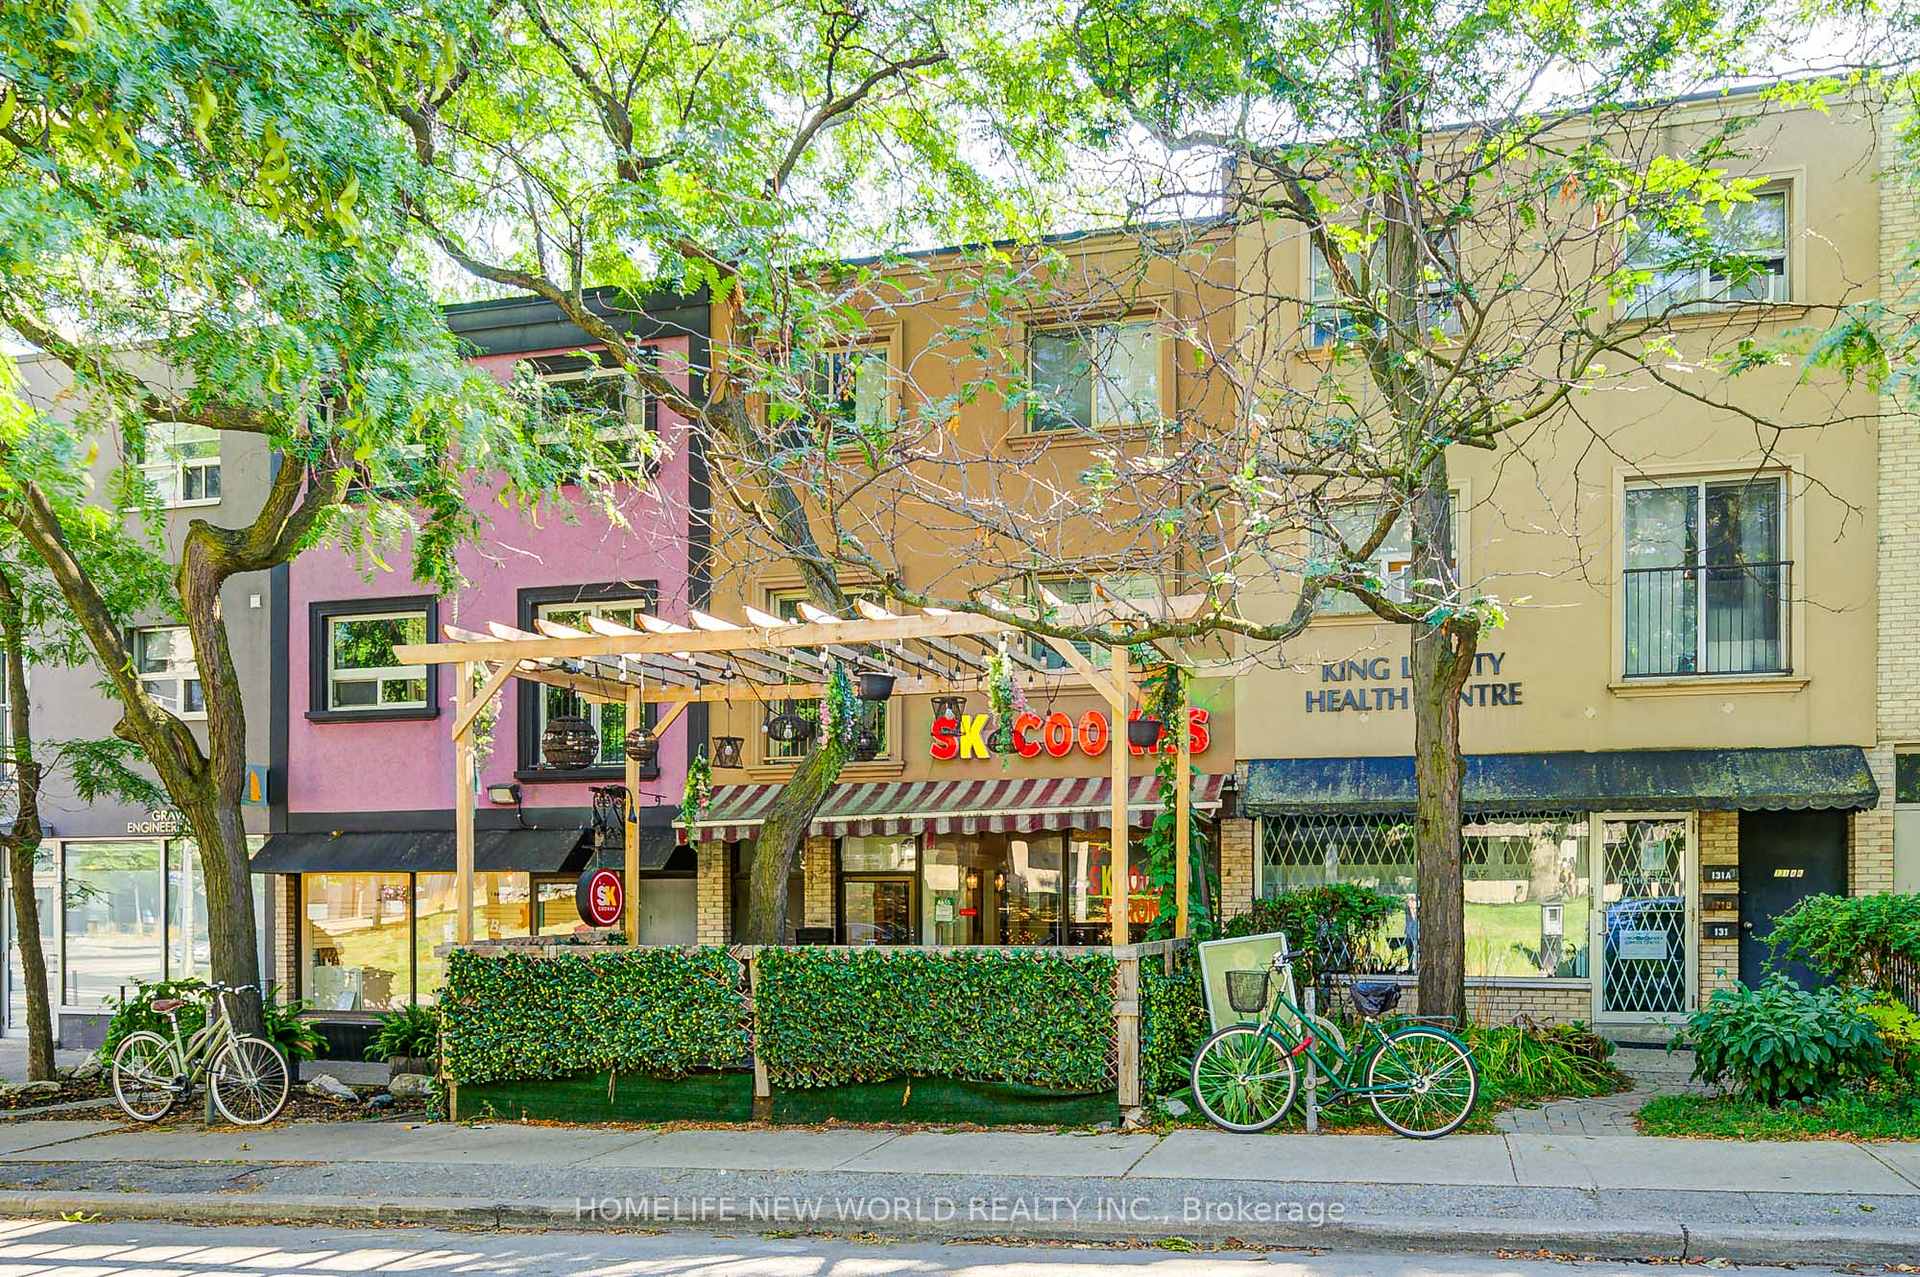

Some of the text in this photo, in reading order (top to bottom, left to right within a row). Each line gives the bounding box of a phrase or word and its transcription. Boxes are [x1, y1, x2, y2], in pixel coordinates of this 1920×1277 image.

[1322, 657, 1390, 682] KING
[1306, 682, 1523, 712] HEALTH NTRE
[930, 707, 1210, 760] SK COOS
[1712, 871, 1731, 880] 131A
[597, 885, 617, 906] SK
[1714, 928, 1728, 936] 131
